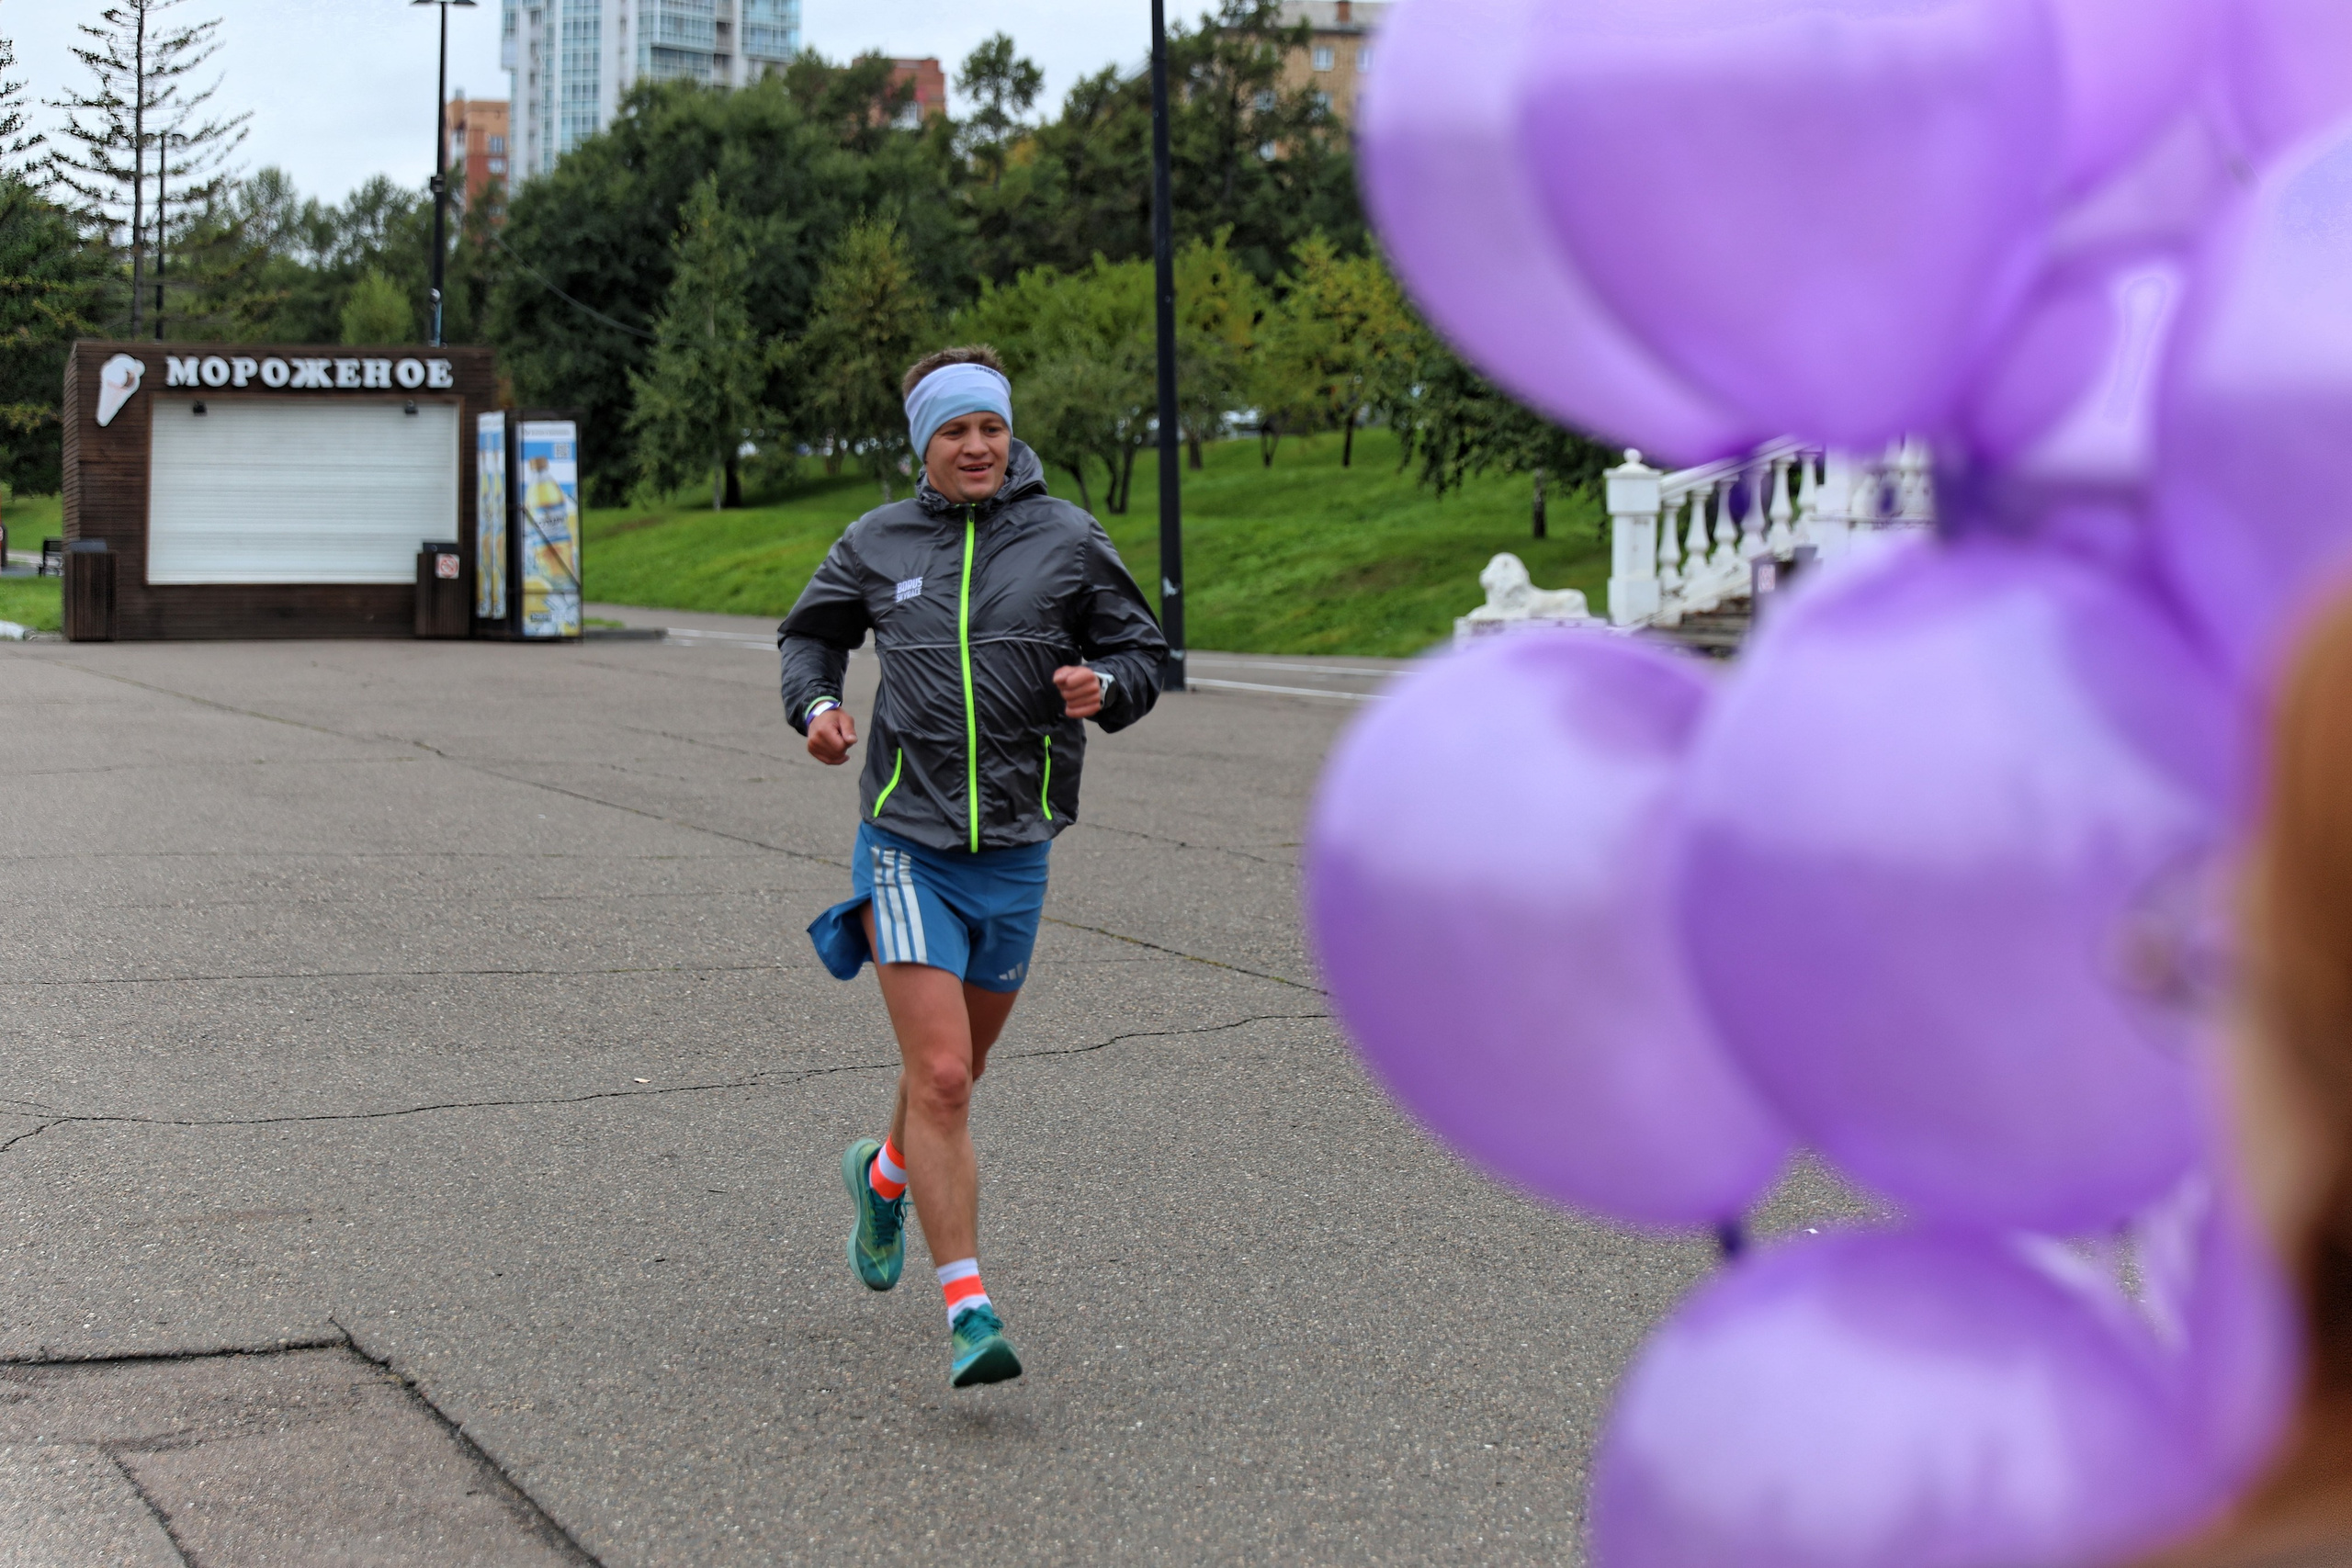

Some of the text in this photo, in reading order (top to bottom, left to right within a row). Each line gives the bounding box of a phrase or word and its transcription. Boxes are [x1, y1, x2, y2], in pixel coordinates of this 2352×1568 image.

[164, 355, 454, 389] МОРОЖЕНОЕ
[897, 577, 923, 593] BORUS
[896, 588, 922, 603] SKYRACE
